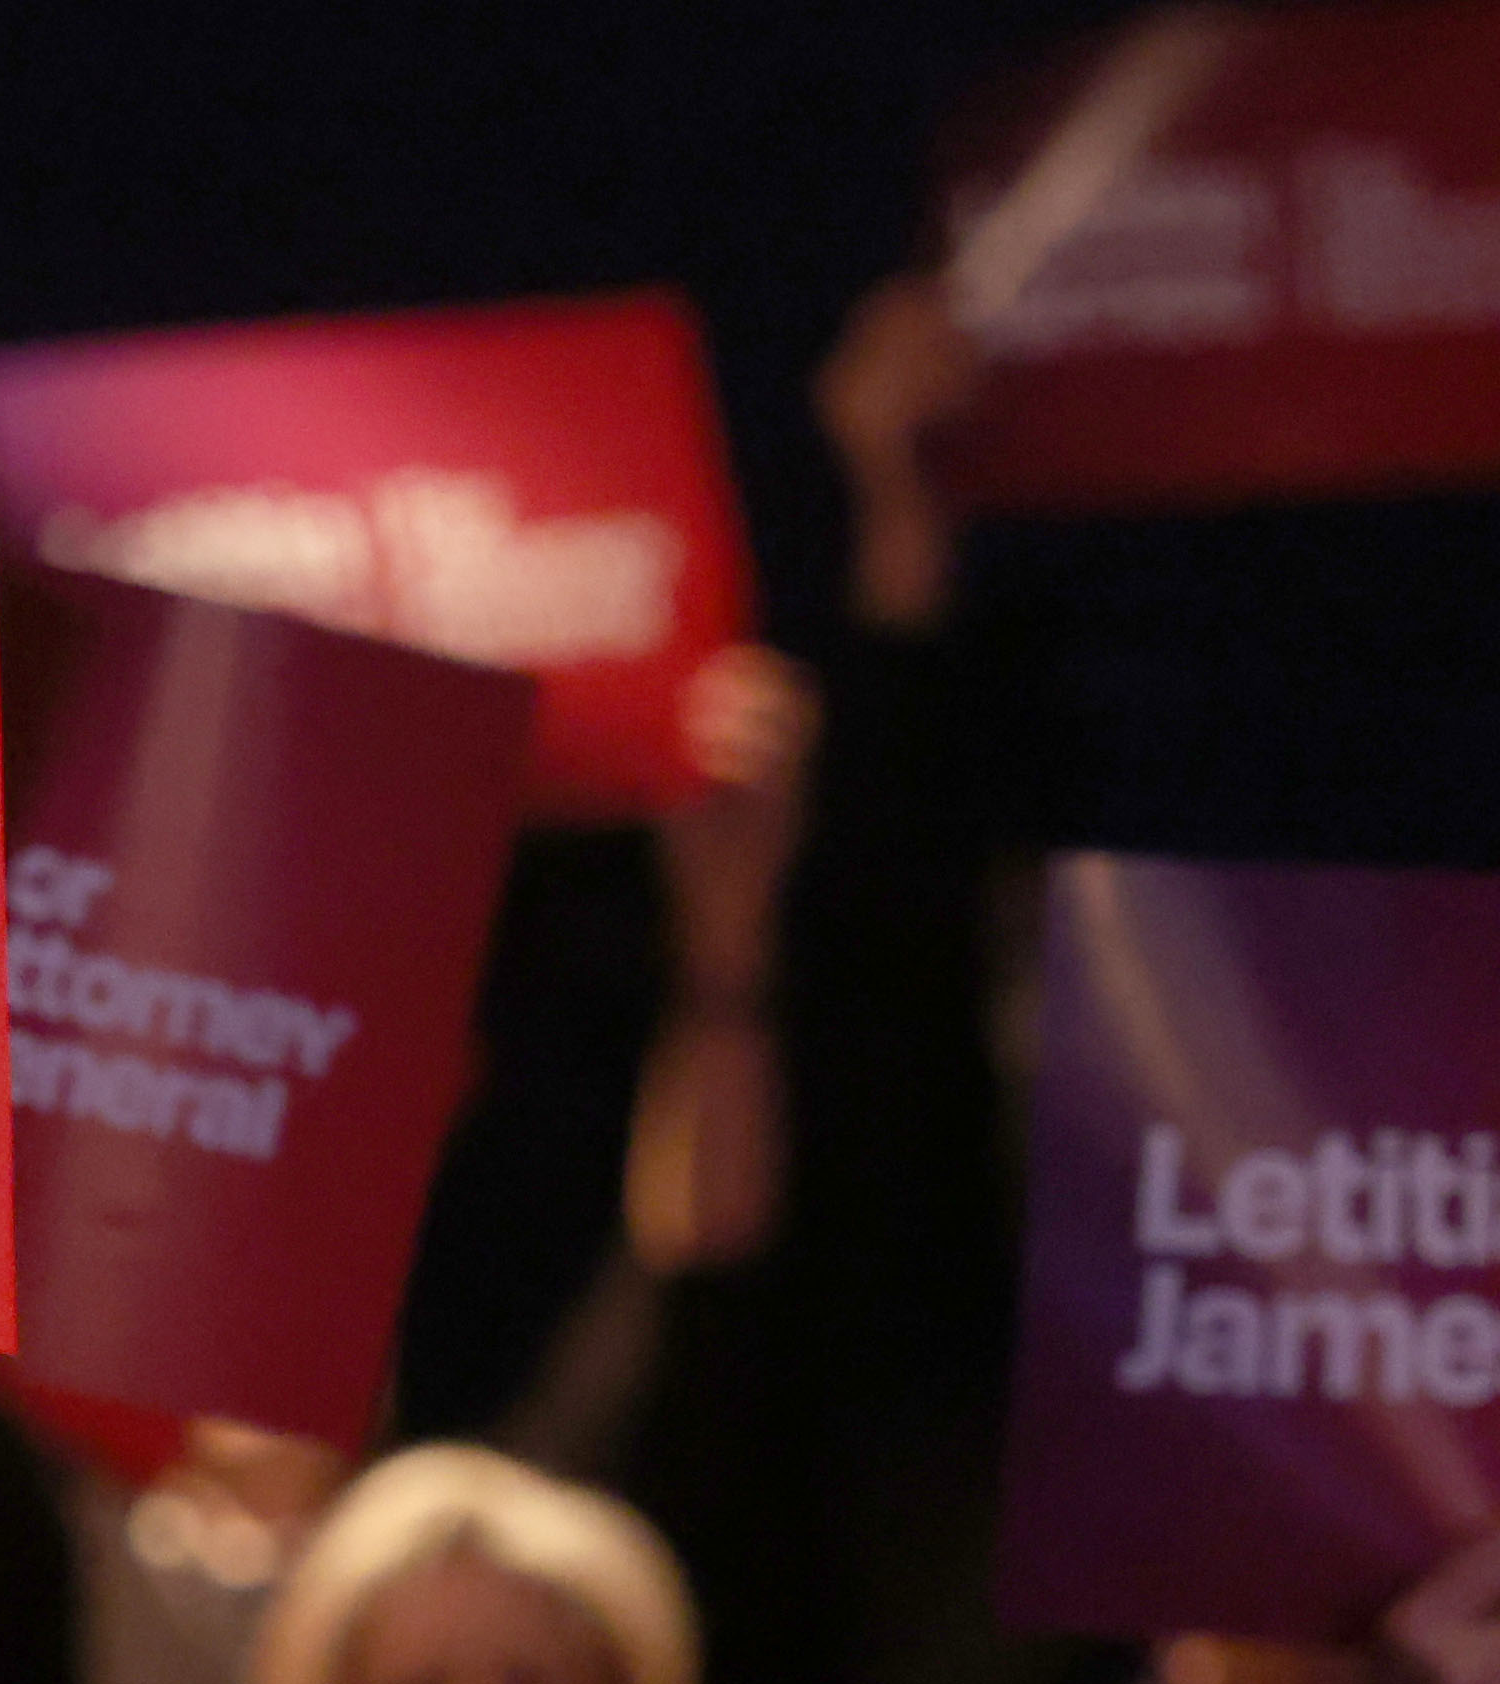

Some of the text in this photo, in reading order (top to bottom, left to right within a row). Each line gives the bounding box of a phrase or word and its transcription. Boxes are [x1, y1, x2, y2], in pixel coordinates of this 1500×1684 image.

[7, 845, 116, 928] or
[1136, 1122, 1500, 1270] Letiti
[1114, 1258, 1500, 1409] Jame
